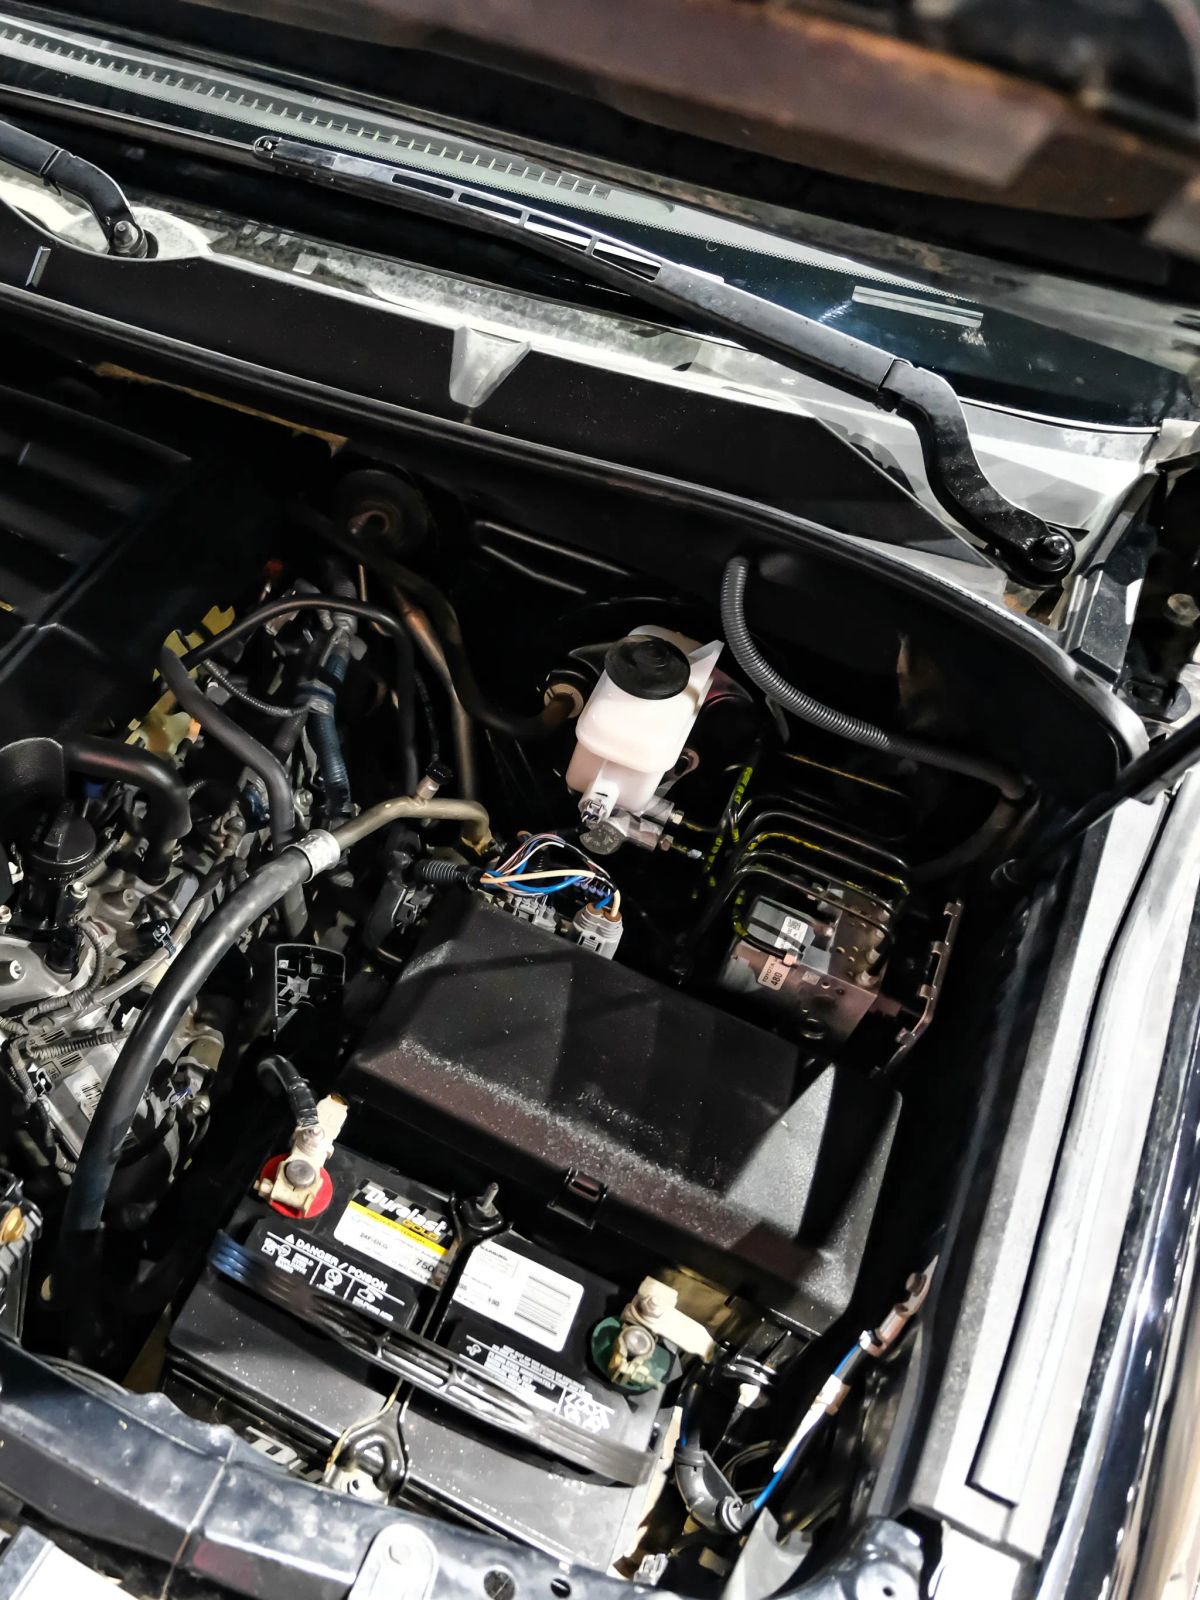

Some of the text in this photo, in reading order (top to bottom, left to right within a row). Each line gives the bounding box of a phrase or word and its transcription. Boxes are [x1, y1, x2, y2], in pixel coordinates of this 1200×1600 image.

[770, 971, 784, 987] 480
[364, 1183, 449, 1237] Duralast
[402, 1219, 440, 1242] GOLD
[295, 1238, 340, 1267] DANGER
[347, 1264, 389, 1292] POISON
[415, 1257, 435, 1273] 750
